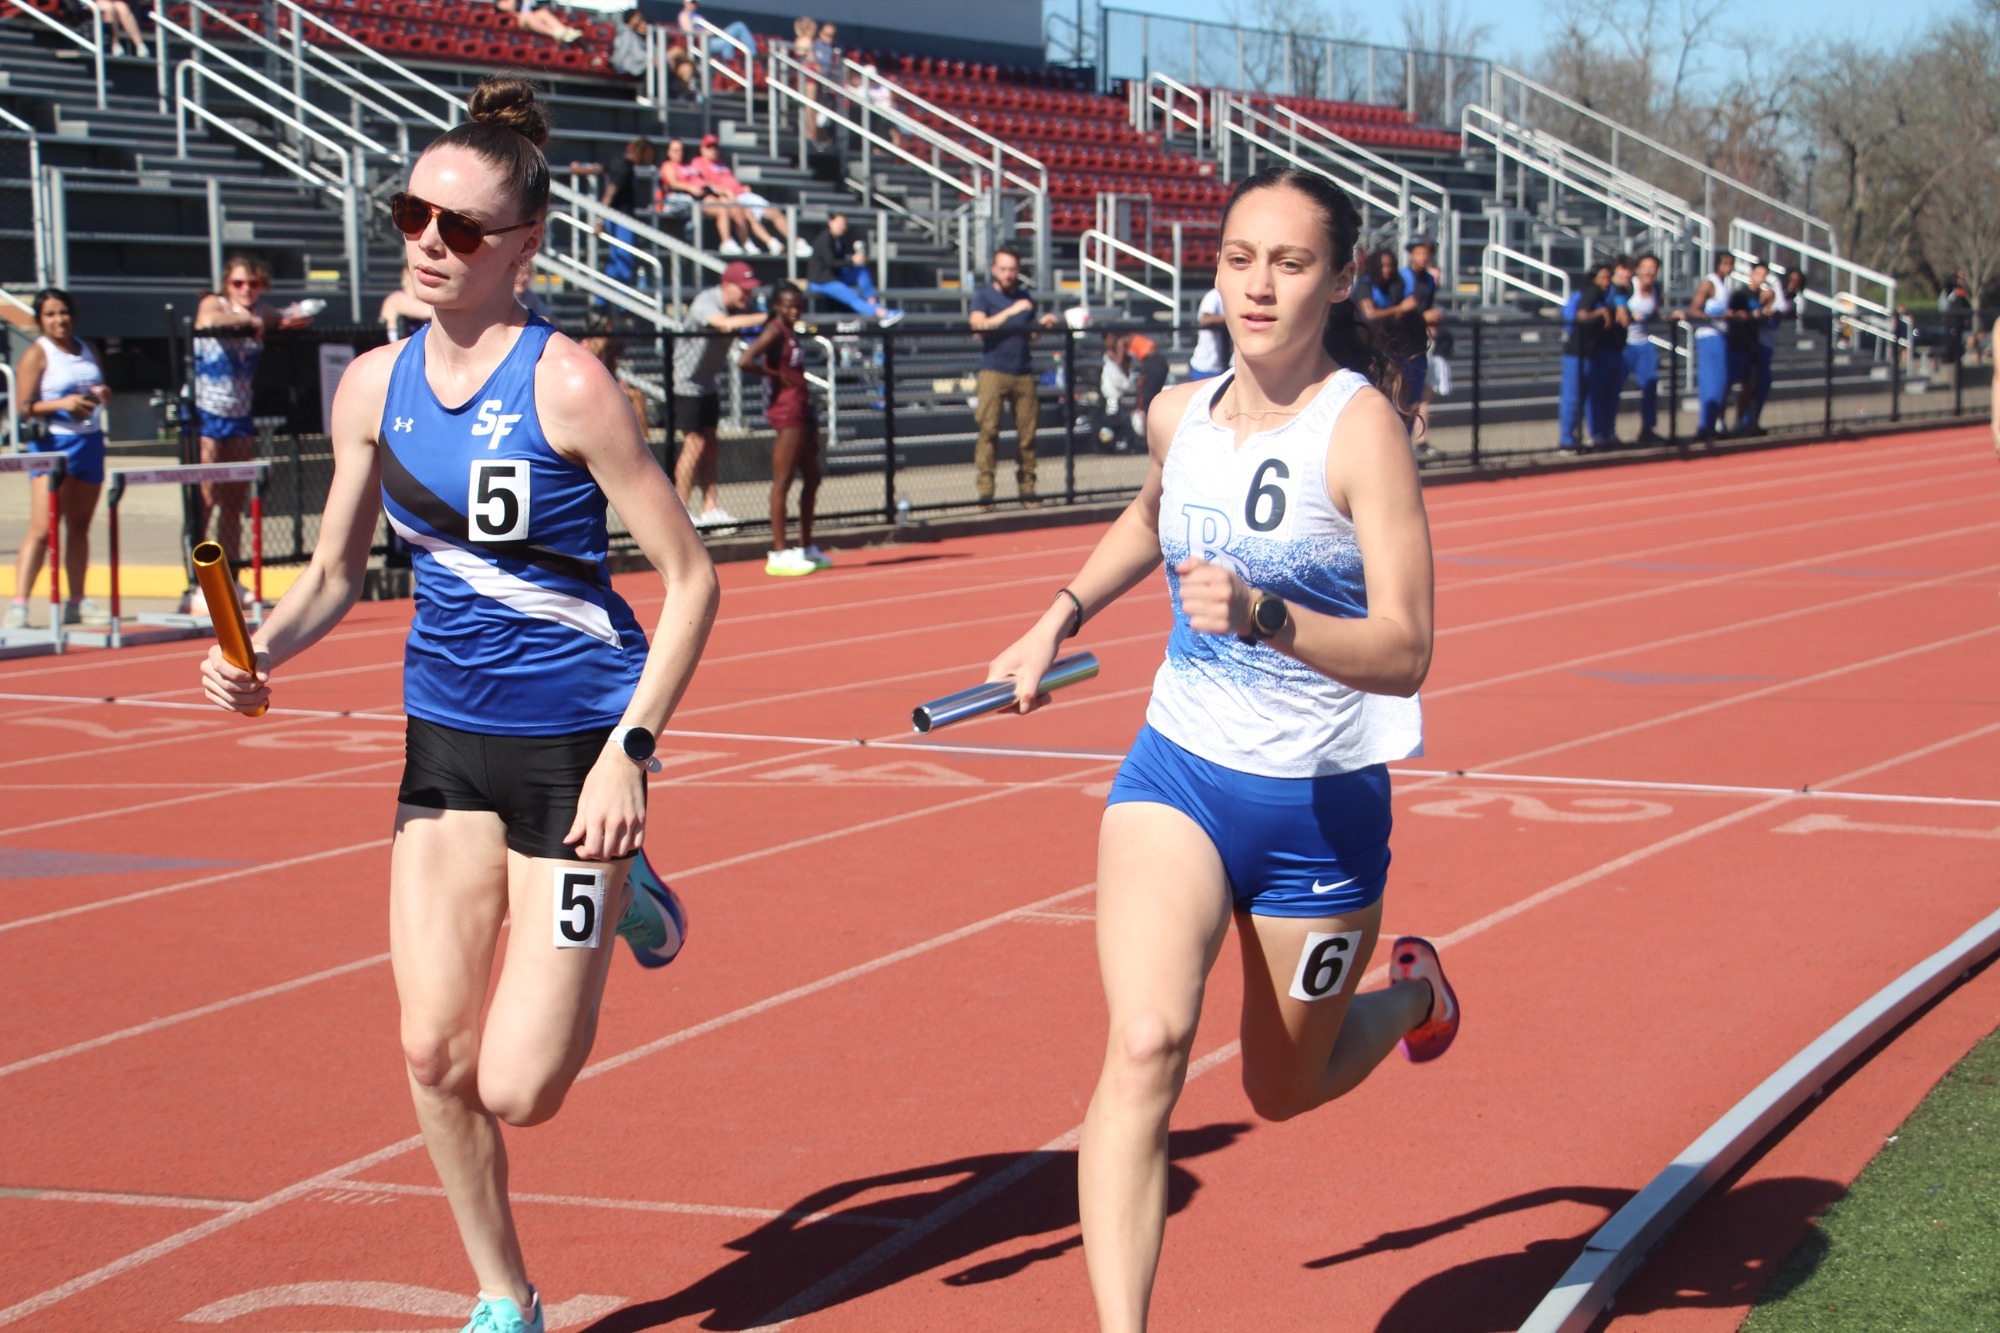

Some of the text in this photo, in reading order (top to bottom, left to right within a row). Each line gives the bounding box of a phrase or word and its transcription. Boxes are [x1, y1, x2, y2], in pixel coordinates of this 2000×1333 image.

[471, 399, 523, 450] SF
[475, 466, 519, 536] 5
[1244, 458, 1290, 533] 6
[751, 759, 985, 785] 4
[1409, 789, 1674, 824] 2
[560, 873, 596, 942] 5
[1301, 937, 1349, 996] 6
